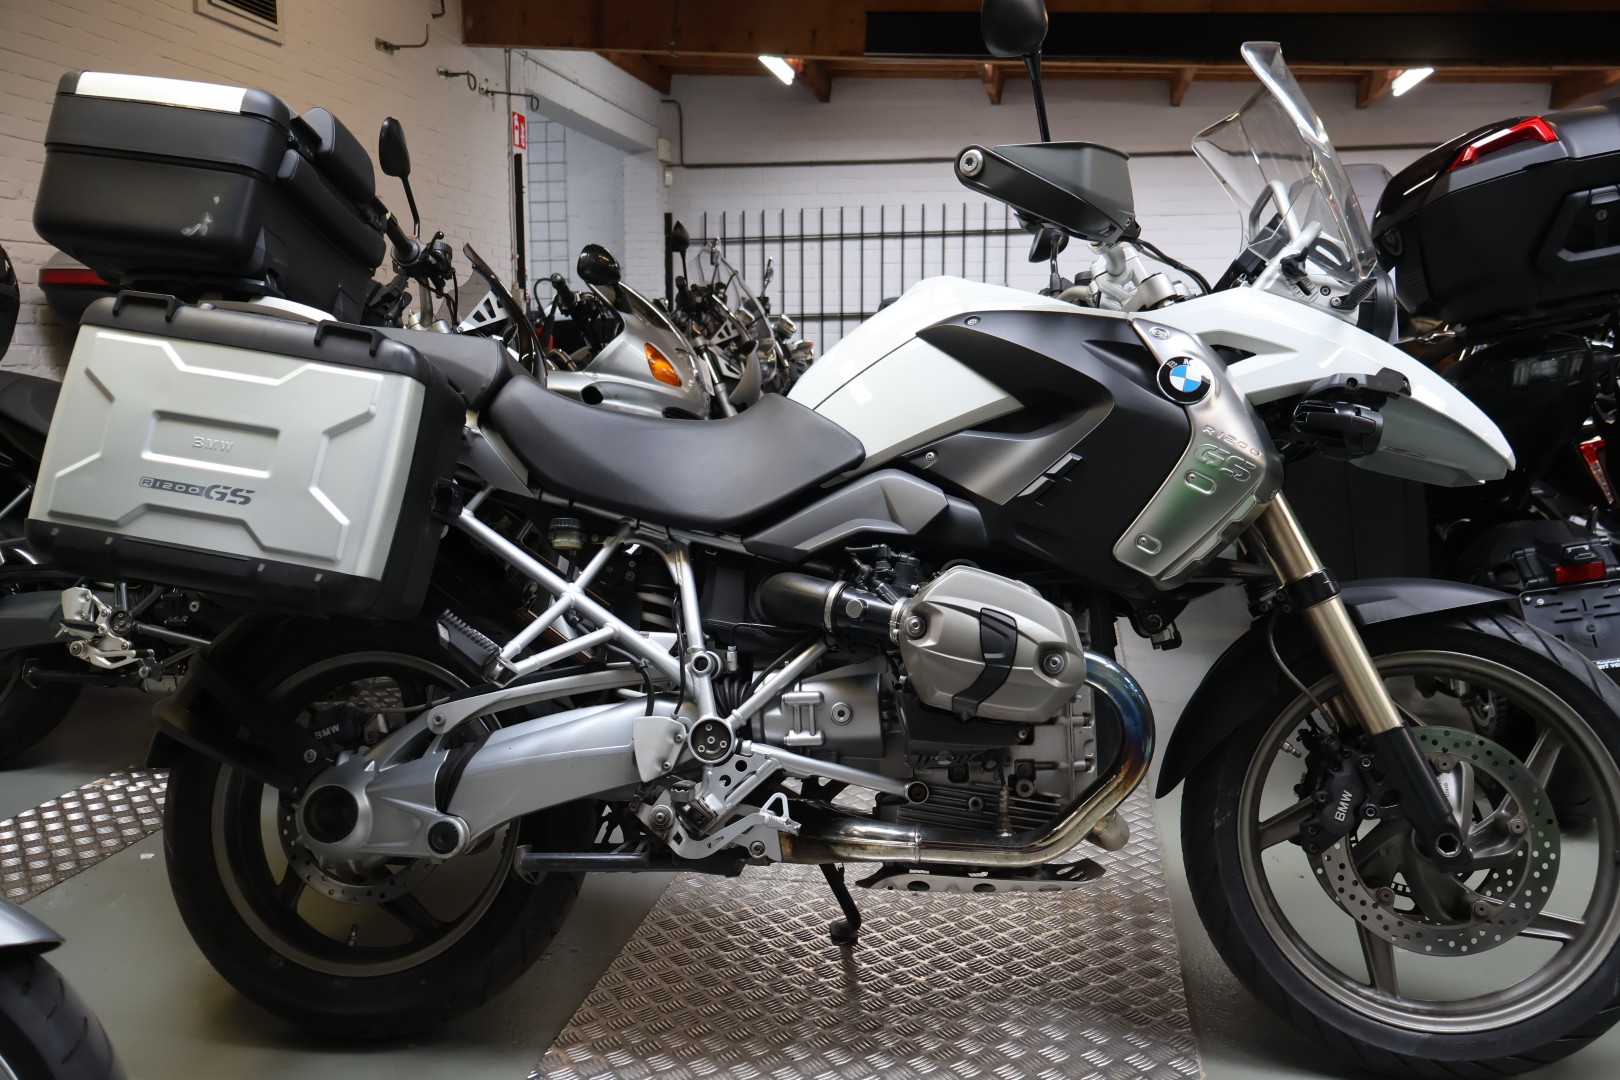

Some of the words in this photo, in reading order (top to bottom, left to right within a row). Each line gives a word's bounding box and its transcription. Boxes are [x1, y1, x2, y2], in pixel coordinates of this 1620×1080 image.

[193, 436, 234, 453] BMW
[1193, 443, 1257, 482] GS
[314, 723, 339, 740] BMW
[1335, 790, 1352, 821] BMW
